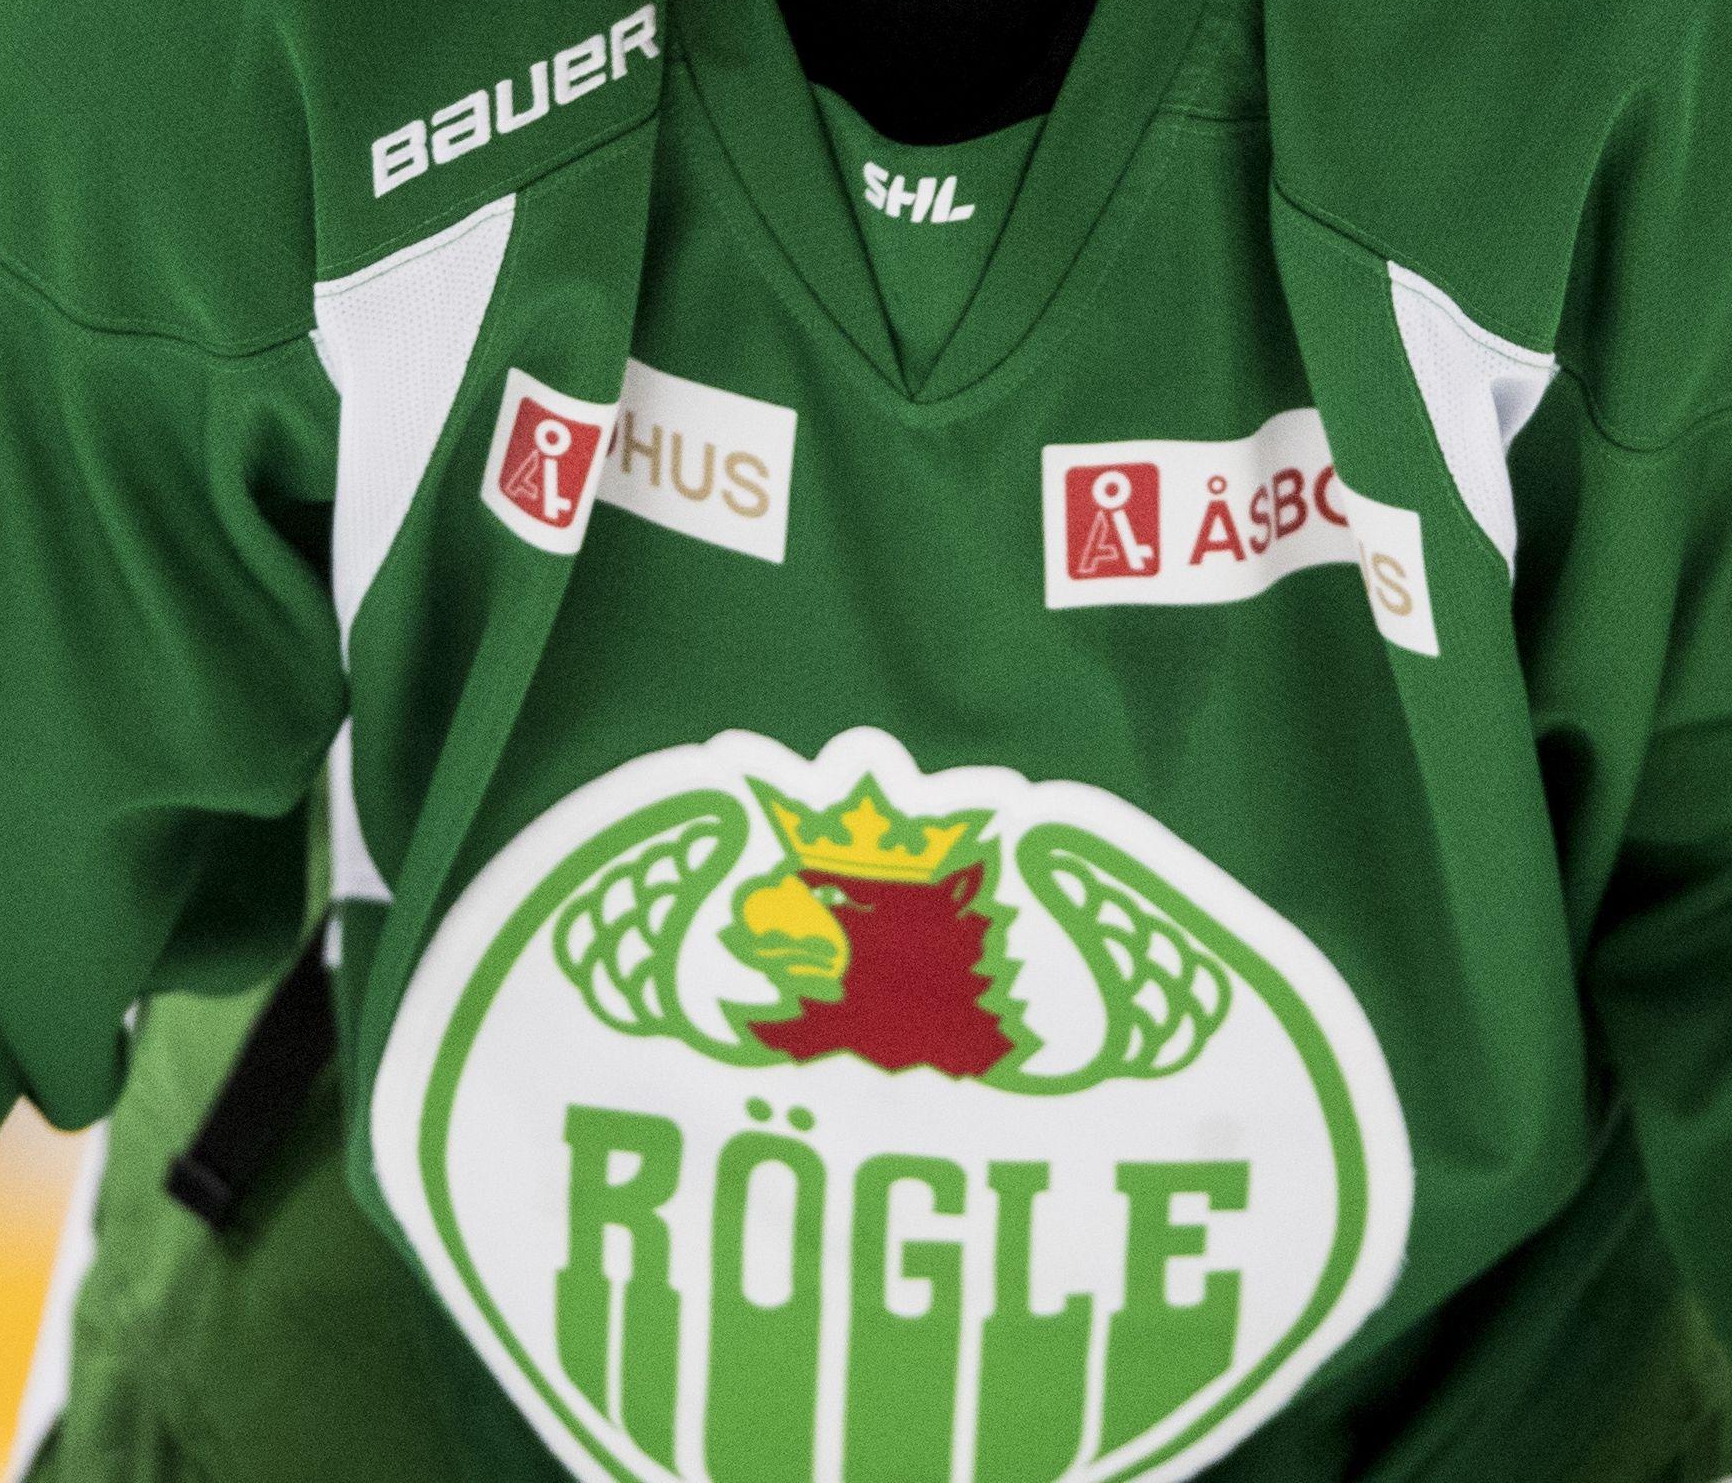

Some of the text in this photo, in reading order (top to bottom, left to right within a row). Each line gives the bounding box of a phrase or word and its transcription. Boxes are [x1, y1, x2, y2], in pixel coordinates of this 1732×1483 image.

[863, 162, 976, 223] SHL
[608, 411, 771, 520] HUS
[555, 1097, 1250, 1386] RÖGLE
